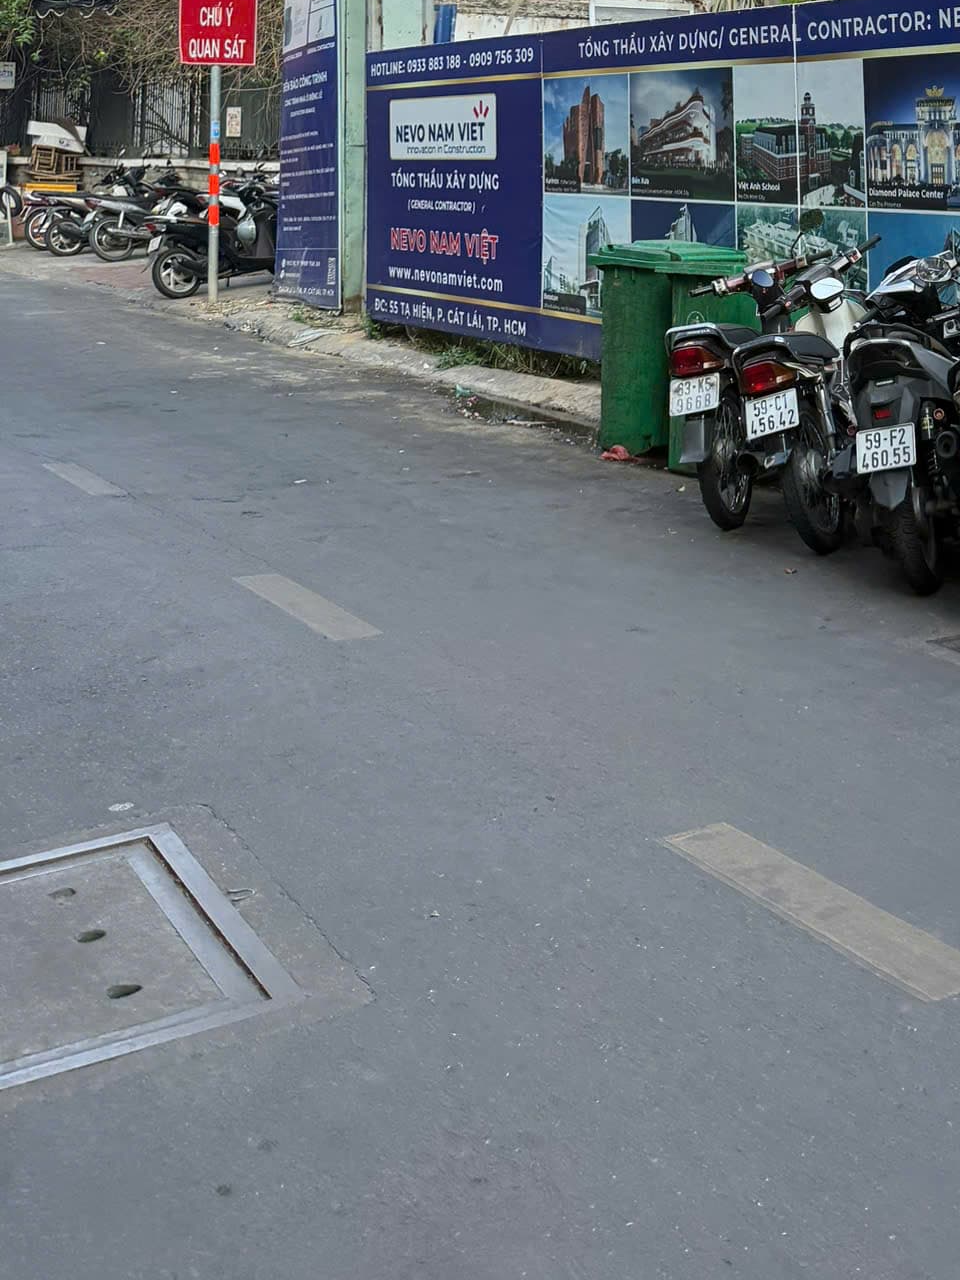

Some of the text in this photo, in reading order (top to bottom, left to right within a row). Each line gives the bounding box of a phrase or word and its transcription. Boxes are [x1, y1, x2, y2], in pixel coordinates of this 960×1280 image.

[199, 1, 234, 27] CHÚ Ý
[189, 34, 246, 59] QUAN SÁT
[578, 35, 609, 58] TỔNG
[612, 31, 645, 55] THẦU
[649, 30, 674, 52] XÂY
[679, 26, 724, 53] DỰNG/
[729, 24, 801, 47] GENERAL
[807, 10, 931, 40] CONTRACTOR:
[371, 47, 533, 76] HOTLINE: 0933 883 188 0909 756 309
[396, 122, 484, 142] NEVO NAM VIET
[391, 167, 499, 193] TỔNG THẦU XÂY DỰNG
[737, 180, 782, 191] Việt Anh School
[867, 187, 944, 199] Diamond Palace Center
[391, 226, 498, 264] NEVO NAM VIỆT
[388, 266, 502, 291] www.nevonamviet.com
[374, 297, 526, 336] ĐC: 55 TẠ HIỆN, P. CÁT LÁI, TP. HCM
[753, 394, 788, 417] 59-C1
[751, 409, 795, 435] 456.42
[865, 428, 905, 450] 59-F2
[862, 446, 911, 470] 460.55
